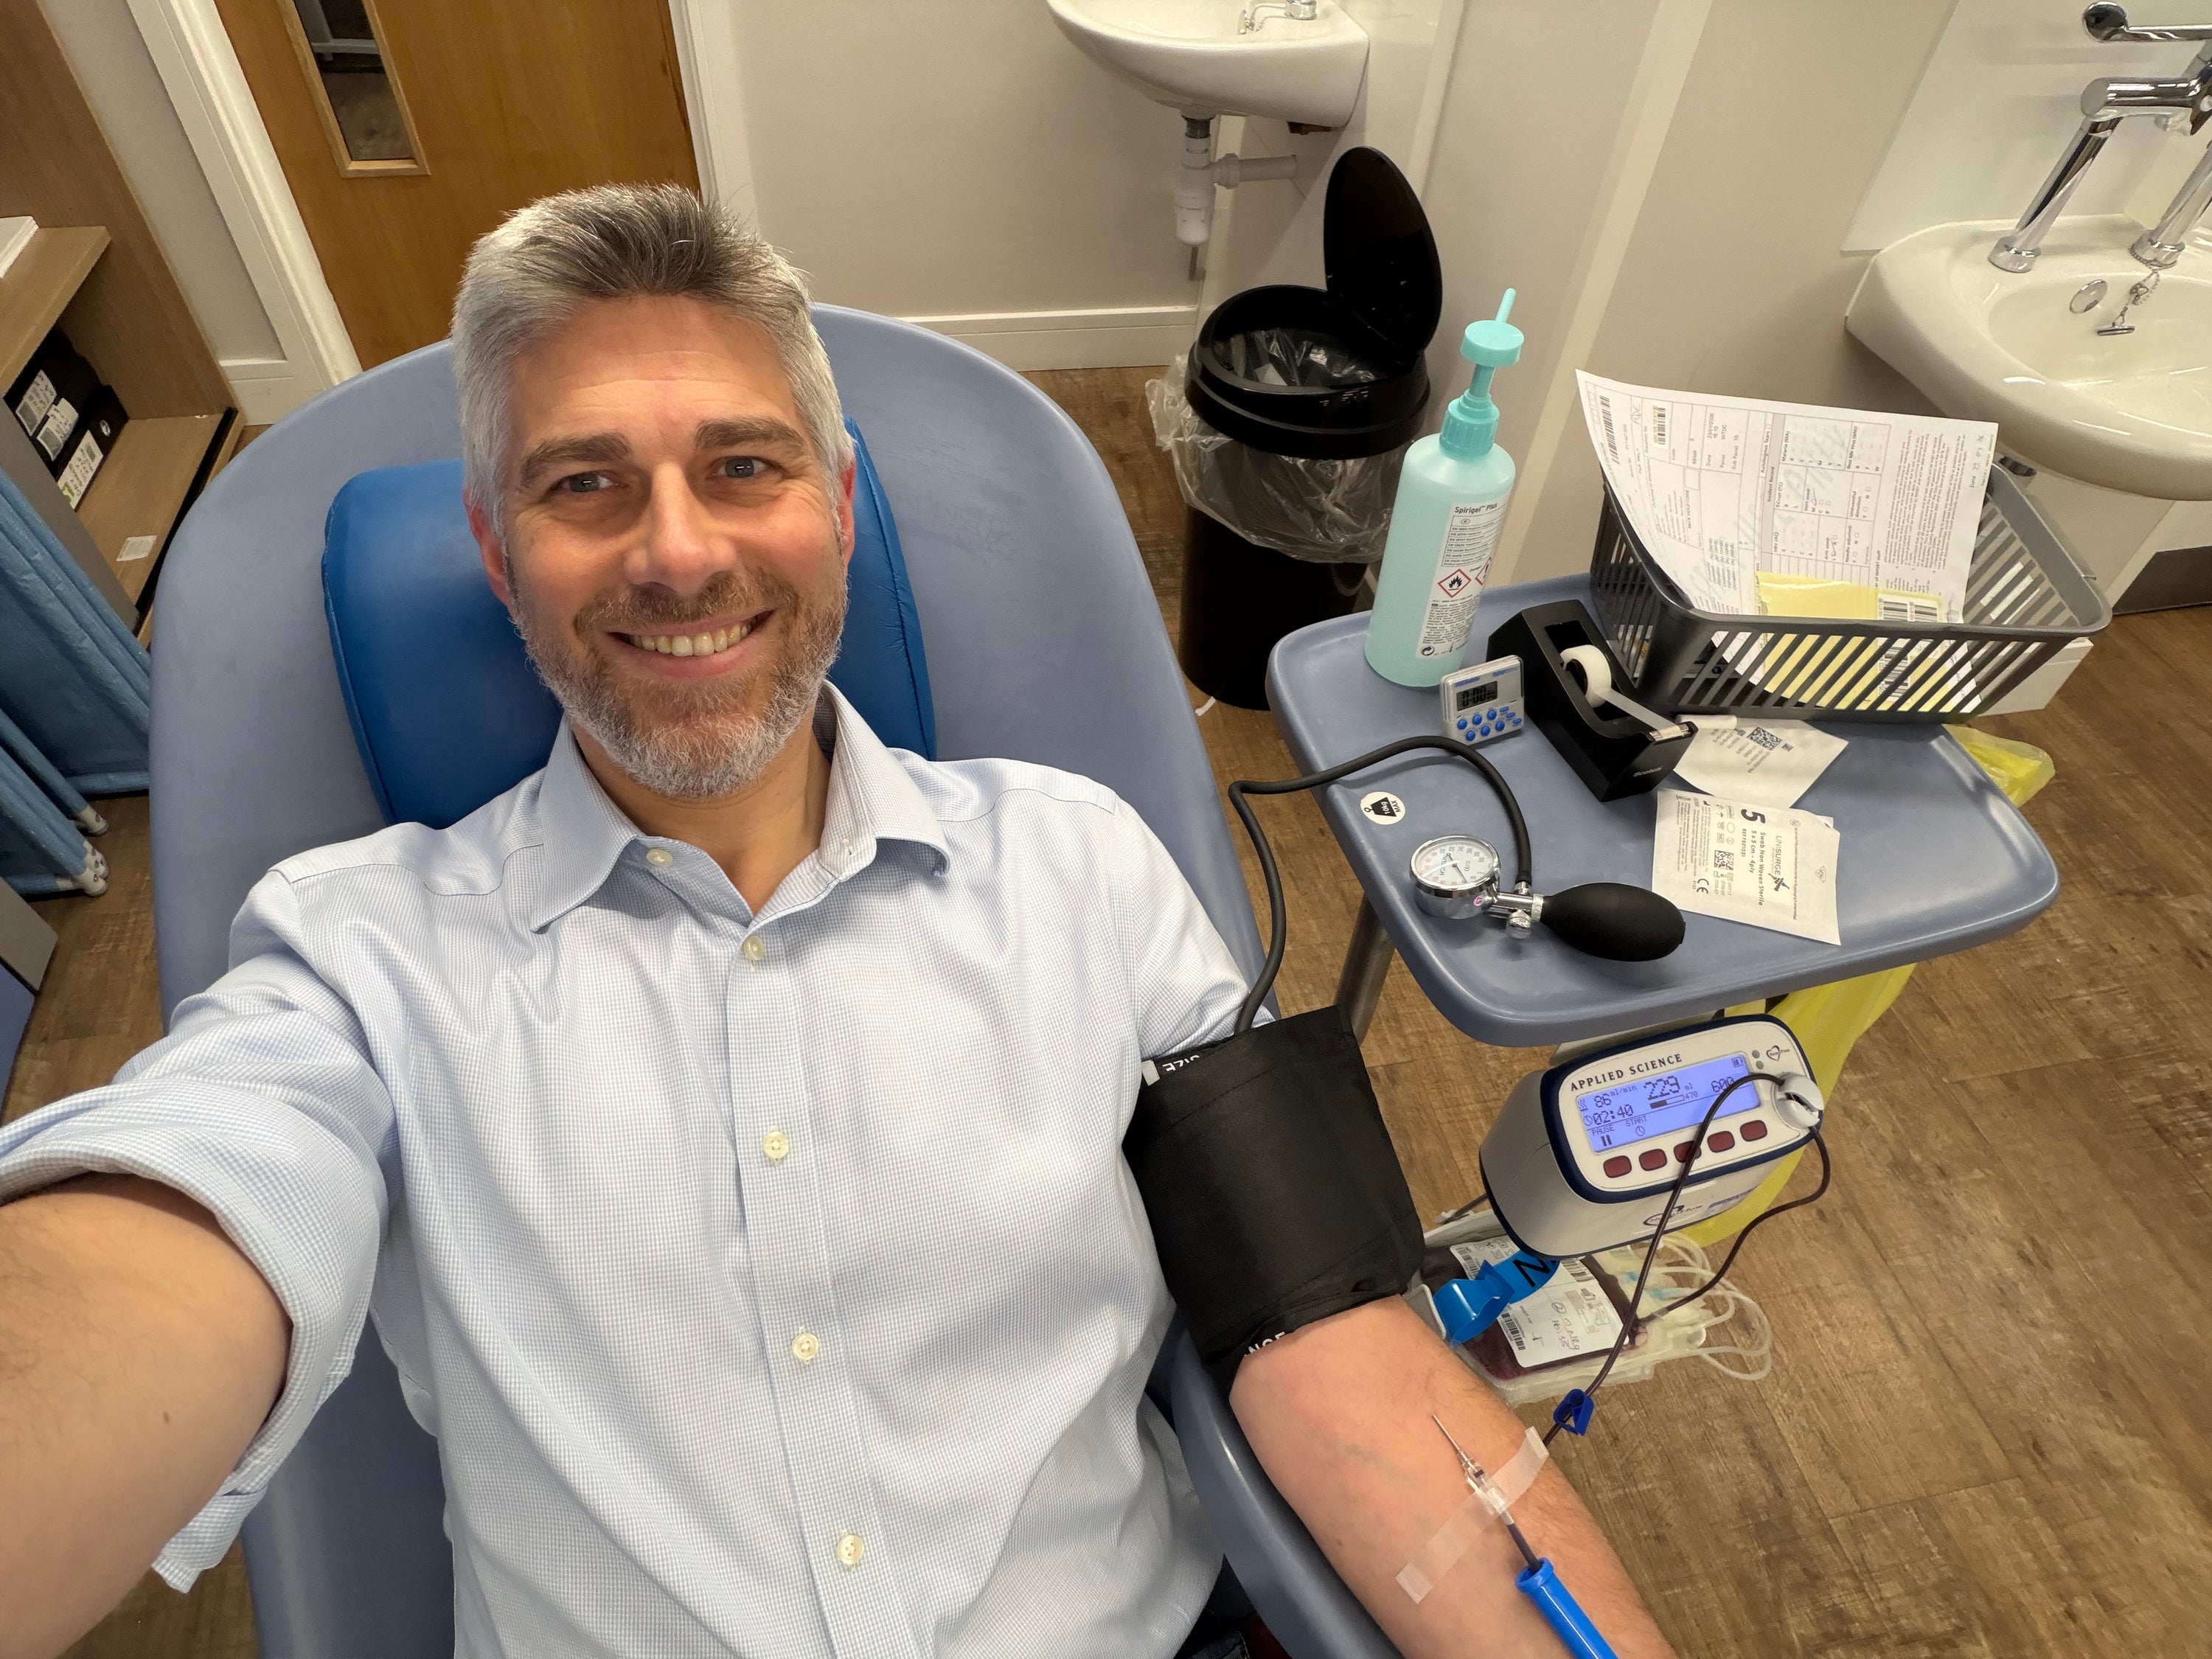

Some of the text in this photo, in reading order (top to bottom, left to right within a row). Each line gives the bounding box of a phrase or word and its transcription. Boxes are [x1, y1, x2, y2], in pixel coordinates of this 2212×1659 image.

[1761, 444, 1769, 473] Autologous
[1486, 503, 1498, 511] Plus
[1381, 801, 1391, 814] 10kg
[1391, 800, 1402, 813] MAX
[1739, 809, 1766, 824] 5
[1750, 844, 1756, 853] cm
[1571, 1054, 1682, 1091] APPLIED SCIENCE
[1594, 1093, 1612, 1108] 86
[1610, 1085, 1638, 1096] ml/min
[1644, 1076, 1680, 1101] 229
[1684, 1082, 1694, 1091] ml
[1685, 1091, 1698, 1099] 470
[1593, 1104, 1634, 1126] 02:40
[1592, 1115, 1648, 1136] PAUSE START
